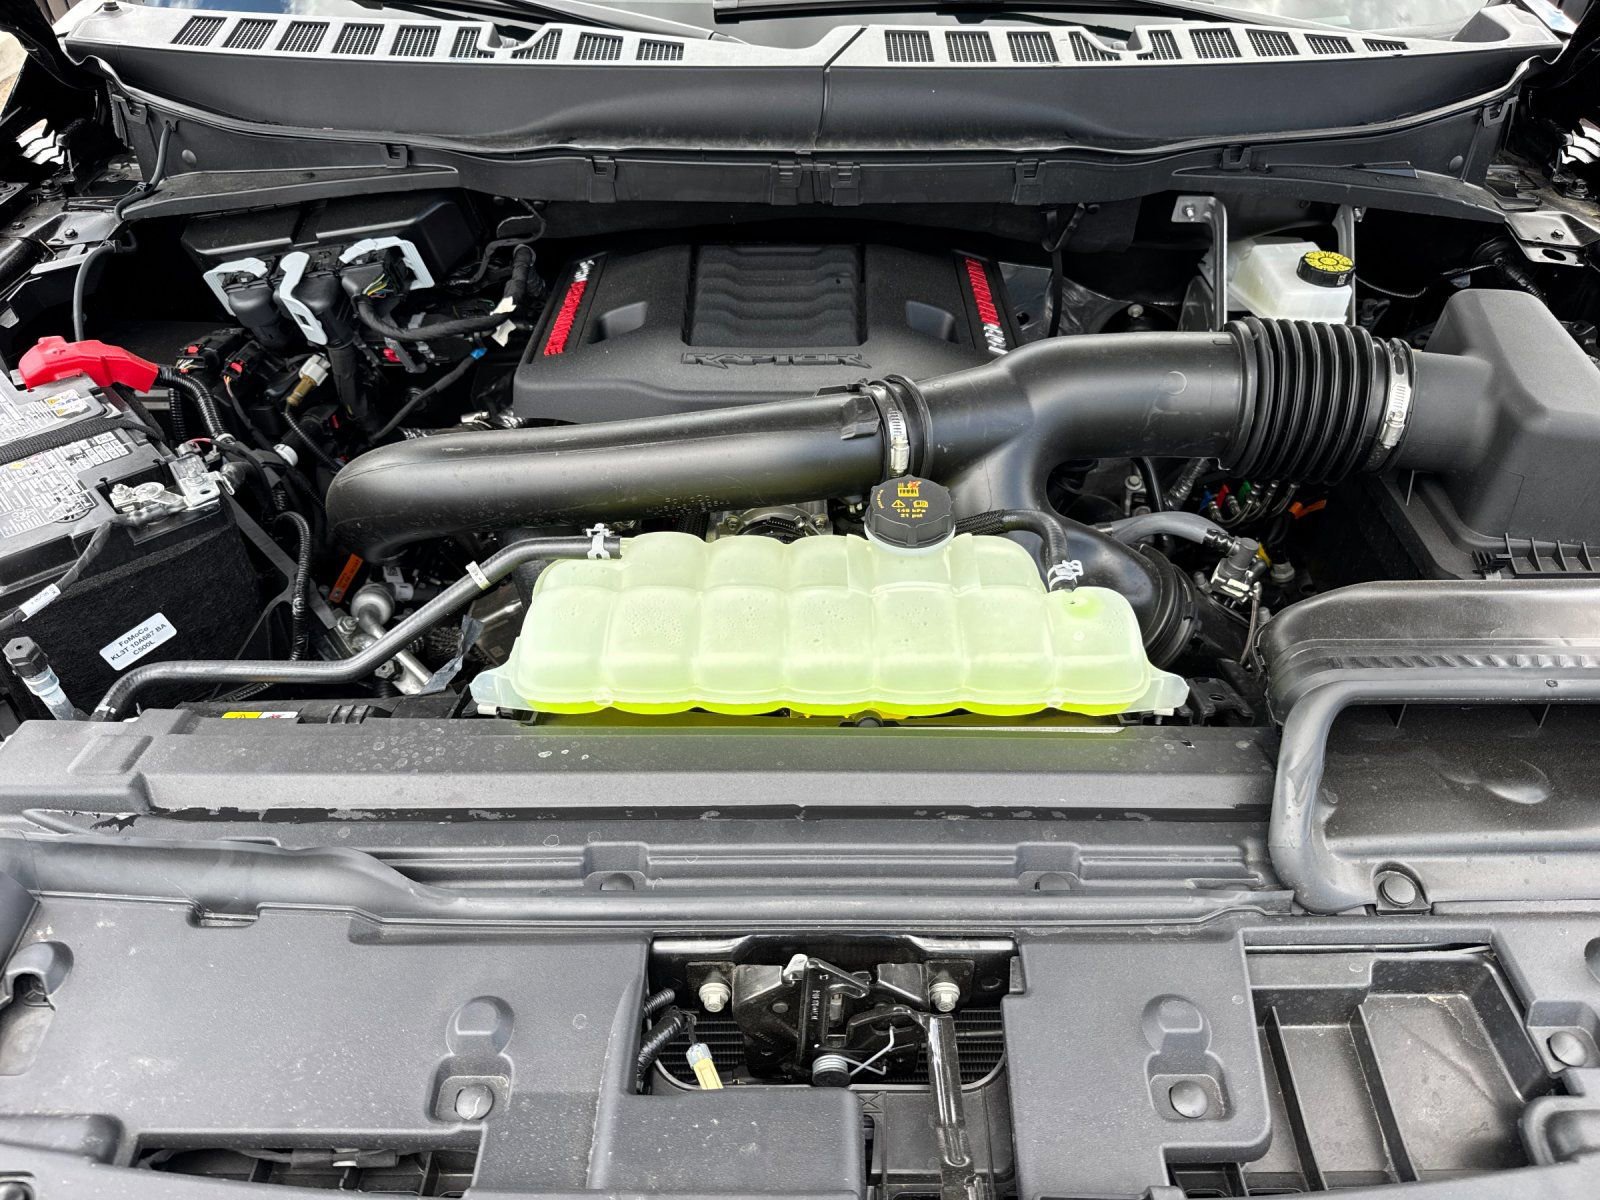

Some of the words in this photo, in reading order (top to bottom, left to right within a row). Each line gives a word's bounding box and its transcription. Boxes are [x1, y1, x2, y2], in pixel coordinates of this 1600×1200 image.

[681, 352, 873, 370] RAPTOR
[118, 626, 149, 647] FoMoCo
[110, 646, 130, 661] KL3T
[132, 640, 156, 656] C500L
